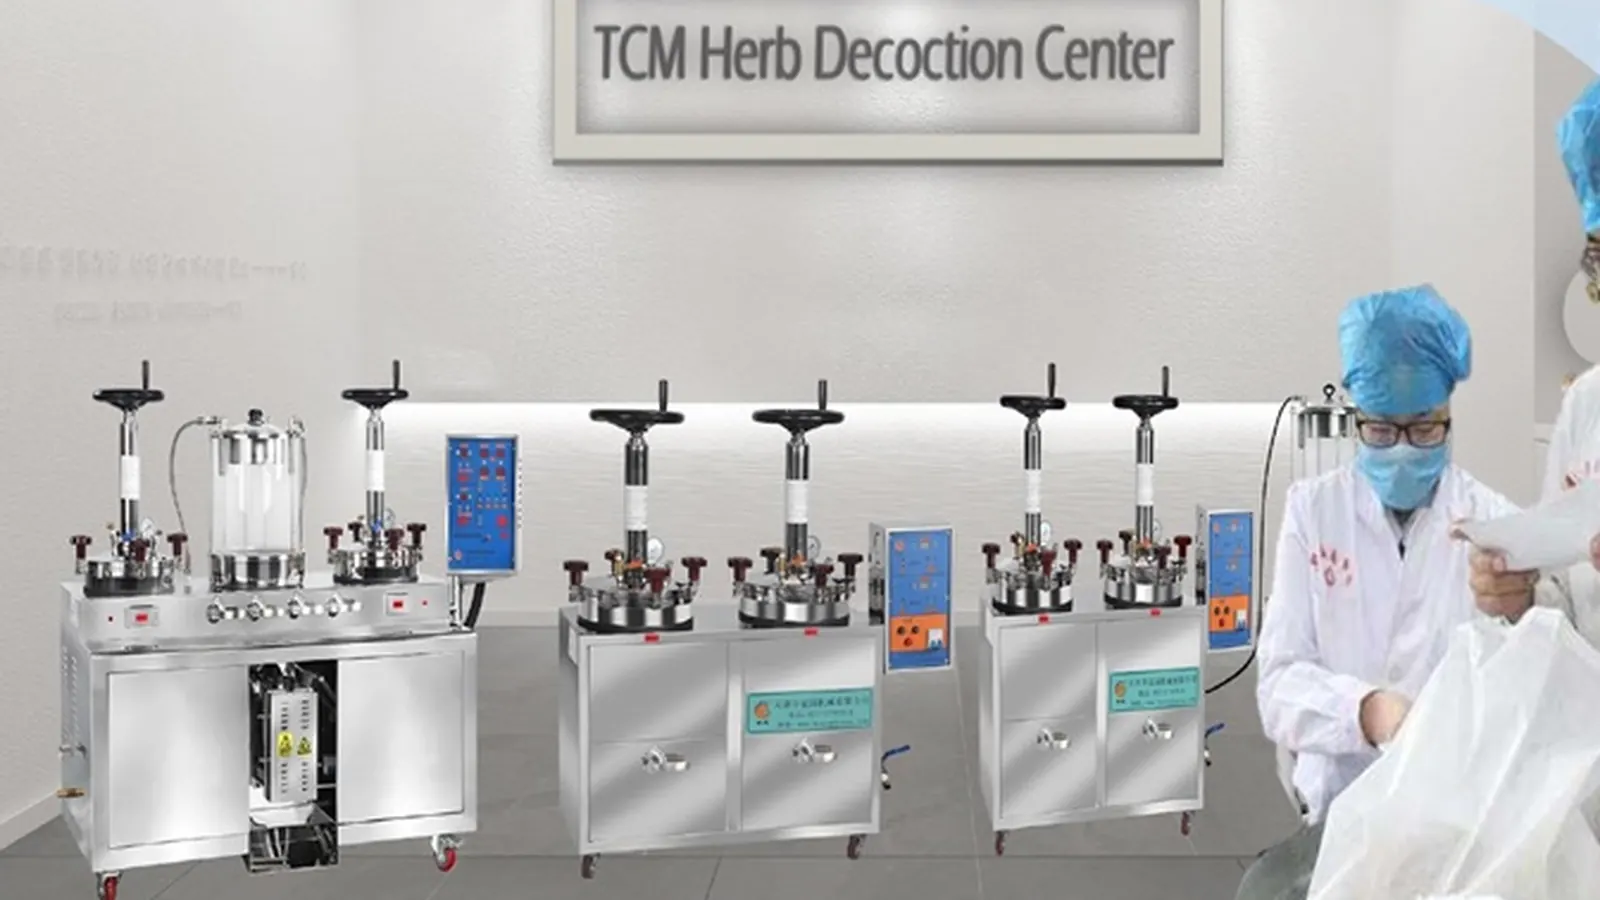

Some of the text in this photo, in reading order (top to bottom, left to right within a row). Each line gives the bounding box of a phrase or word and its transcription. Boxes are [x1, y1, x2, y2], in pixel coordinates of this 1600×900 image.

[593, 24, 1175, 81] TCM Herb Decoction Center
